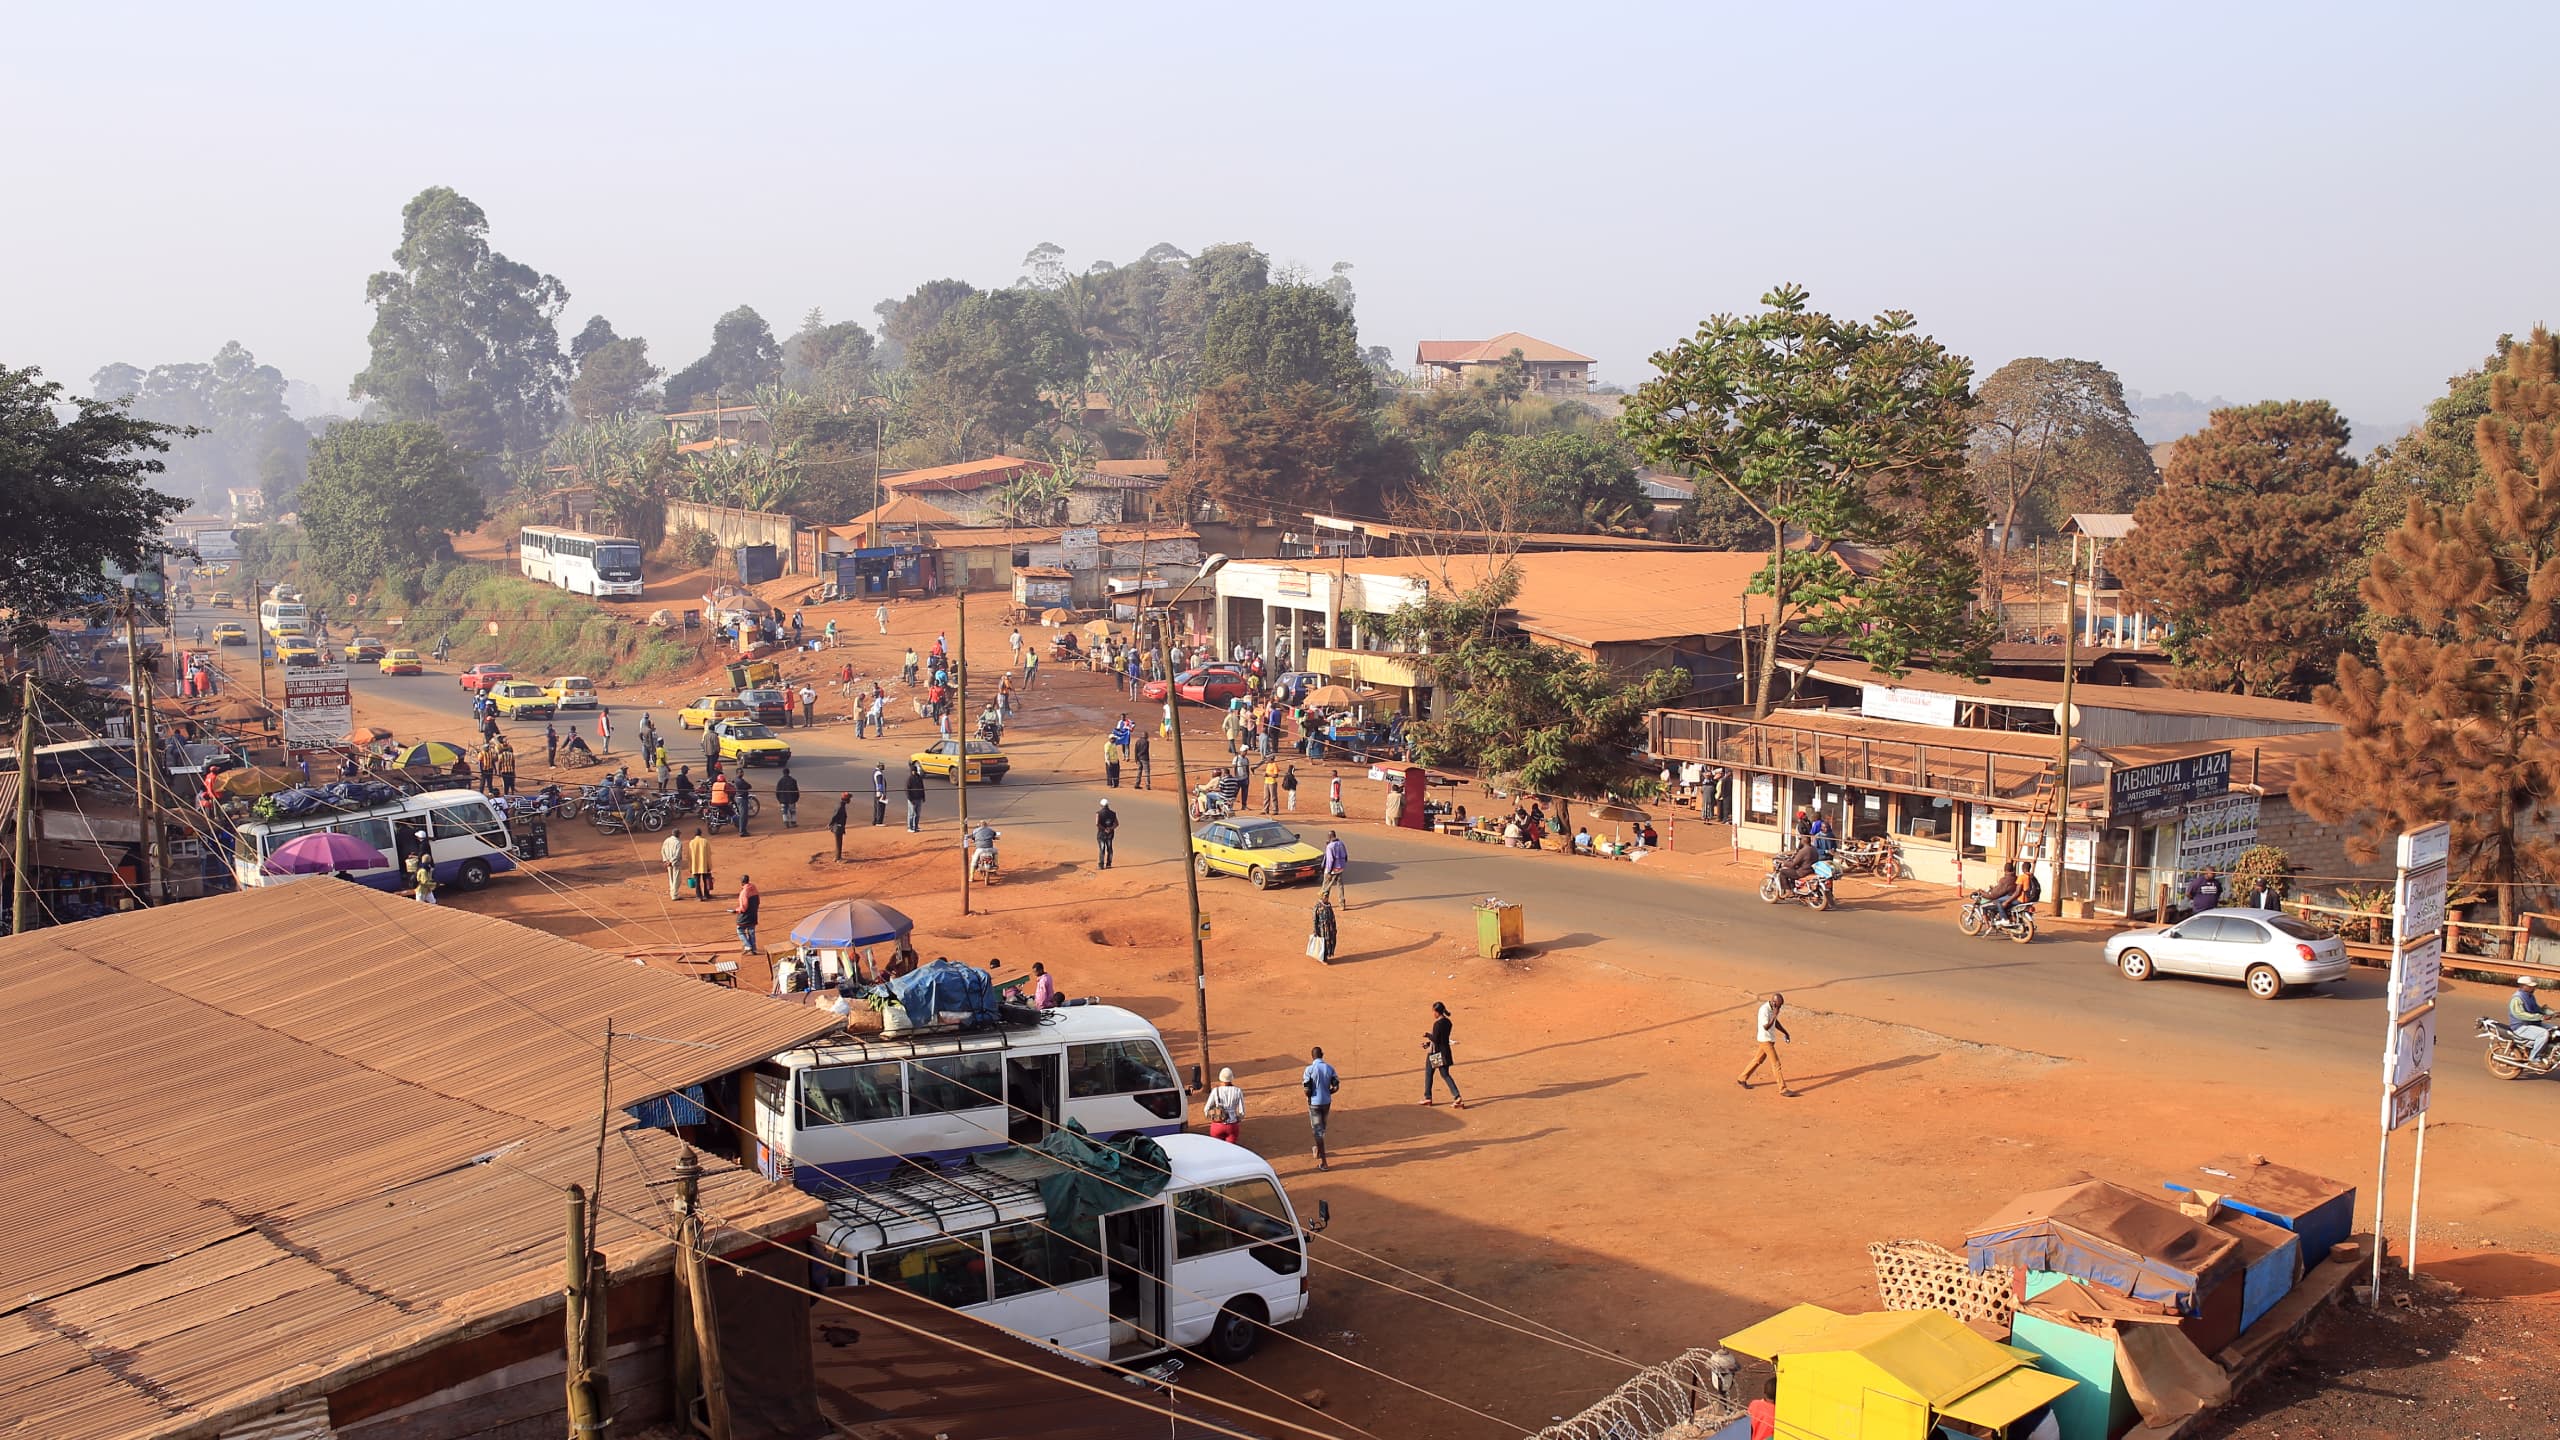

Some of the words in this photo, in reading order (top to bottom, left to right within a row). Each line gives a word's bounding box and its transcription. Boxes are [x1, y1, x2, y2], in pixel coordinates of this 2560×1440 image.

[2116, 762, 2180, 792] TABOUGUIA
[2192, 754, 2227, 778] PLAZA
[2127, 787, 2162, 802] PATISSERIE
